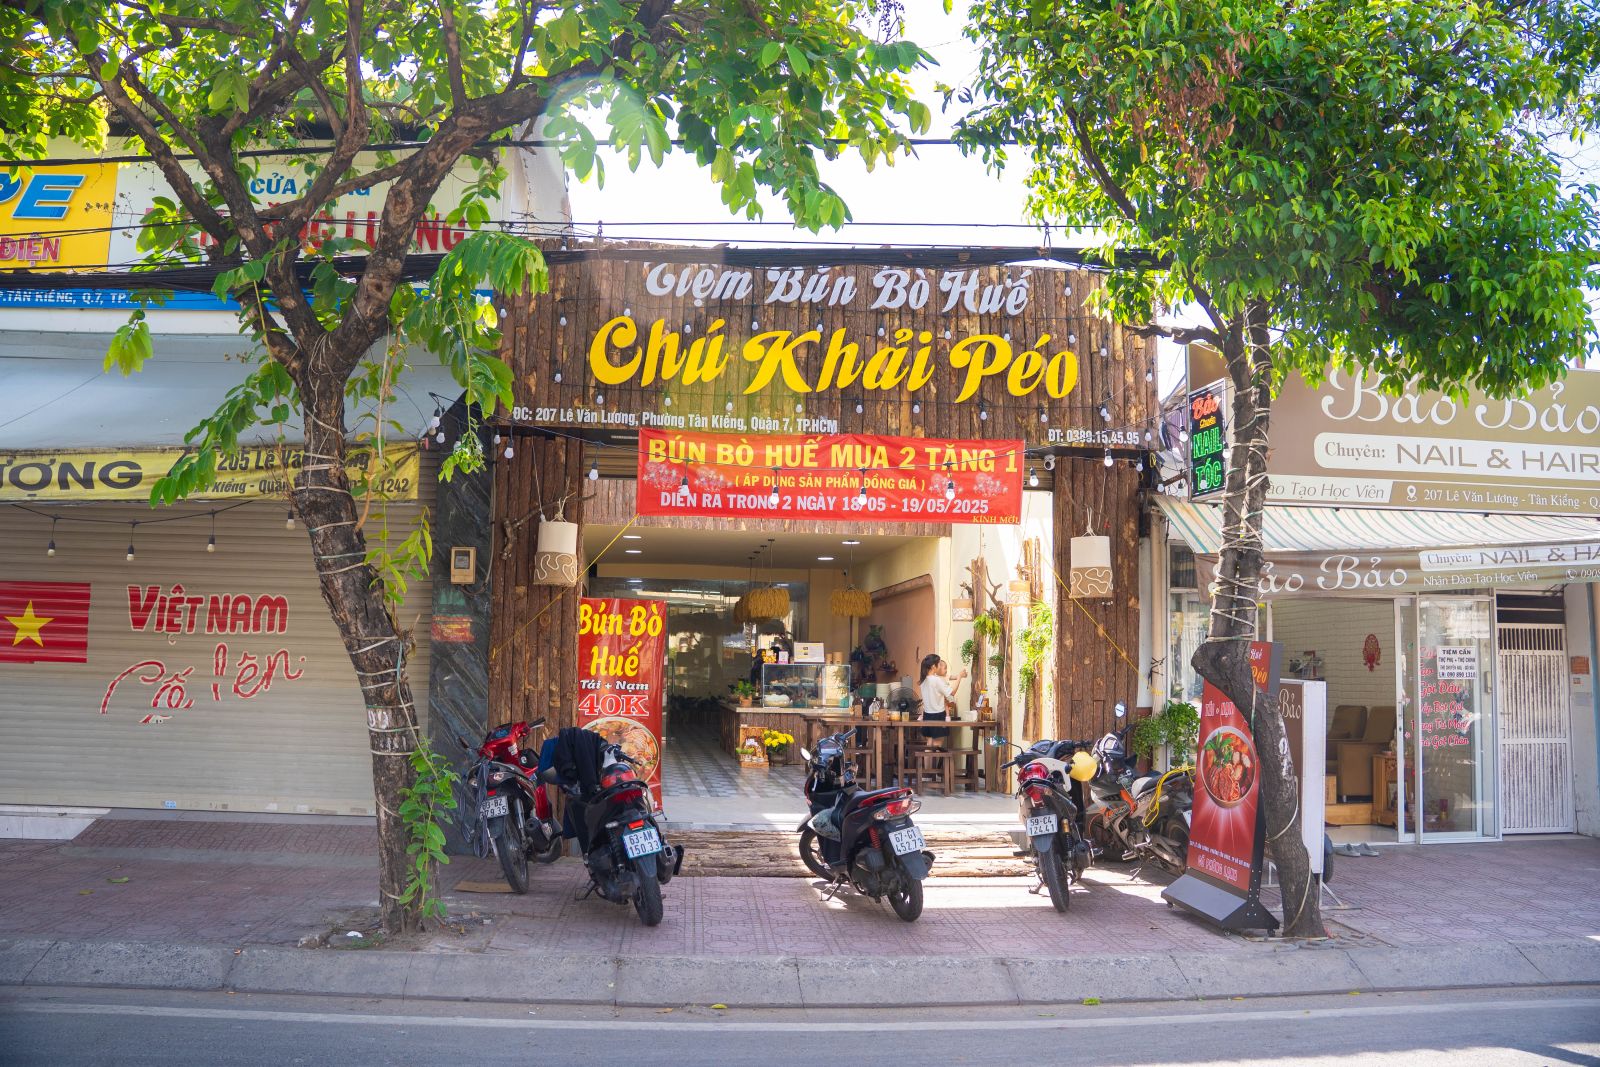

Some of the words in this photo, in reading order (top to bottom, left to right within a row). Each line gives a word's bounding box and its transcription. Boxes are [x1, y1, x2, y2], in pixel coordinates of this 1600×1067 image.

[250, 173, 297, 195] CỬA
[765, 266, 857, 307] Bún
[871, 268, 930, 310] Bò
[939, 269, 1030, 316] Huế
[590, 316, 728, 388] Chú
[743, 327, 934, 395] Khải
[950, 334, 1078, 403] Péo
[512, 407, 532, 420] ĐC:
[535, 407, 557, 421] 207
[560, 408, 574, 422] Lê
[576, 409, 598, 423] Văn
[601, 411, 639, 427] Lương,
[642, 411, 684, 429] Phường
[688, 413, 708, 428] Tân
[711, 413, 748, 430] Kiểng,
[751, 416, 780, 433] Quận
[1048, 429, 1063, 441] ĐT:
[1193, 427, 1222, 459] NAIL
[217, 450, 251, 471] 205
[255, 449, 275, 470] Lê
[649, 435, 706, 465] BÚN
[716, 438, 754, 467] BÒ
[765, 436, 818, 467] HUẾ
[831, 444, 889, 469] MUA
[899, 447, 915, 470] 2
[925, 444, 995, 473] TĂNG
[1005, 450, 1018, 473] 1
[1324, 441, 1385, 461] Chuyên:
[1397, 443, 1477, 467] NAIL
[1486, 448, 1512, 469] &
[1521, 450, 1600, 473] HAIR
[0, 458, 143, 497] ỢNG
[743, 473, 760, 487] ÁP
[799, 473, 822, 488] SẢN
[826, 472, 859, 488] PHẨM
[898, 476, 917, 490] GIÁ
[1196, 458, 1221, 491] TÓC
[702, 493, 722, 508] RA
[782, 495, 792, 510] 2
[797, 492, 841, 511] NGÀY
[902, 497, 988, 514] 19/05/2025
[1291, 482, 1317, 498] Tạo
[1321, 484, 1350, 500] Học
[1356, 485, 1384, 499] Viên
[1424, 489, 1443, 501] 207
[1446, 489, 1459, 502] Lê
[1462, 490, 1483, 502] Văn
[1486, 492, 1519, 507] Lương
[1528, 493, 1548, 505] Tân
[1551, 494, 1580, 508] Kiểng
[1480, 549, 1541, 564] NAIL
[1547, 547, 1567, 561] &
[1317, 554, 1408, 590] Bảo
[1451, 571, 1472, 586] Đào
[127, 584, 205, 645] VIỆT
[205, 593, 289, 635] NAM
[579, 601, 623, 636] Bún
[630, 603, 663, 637] Bò
[590, 640, 641, 677] Huế
[580, 679, 601, 690] Tái
[615, 680, 649, 692] Nạm
[579, 693, 649, 717] 40K
[630, 840, 659, 856] 150.33
